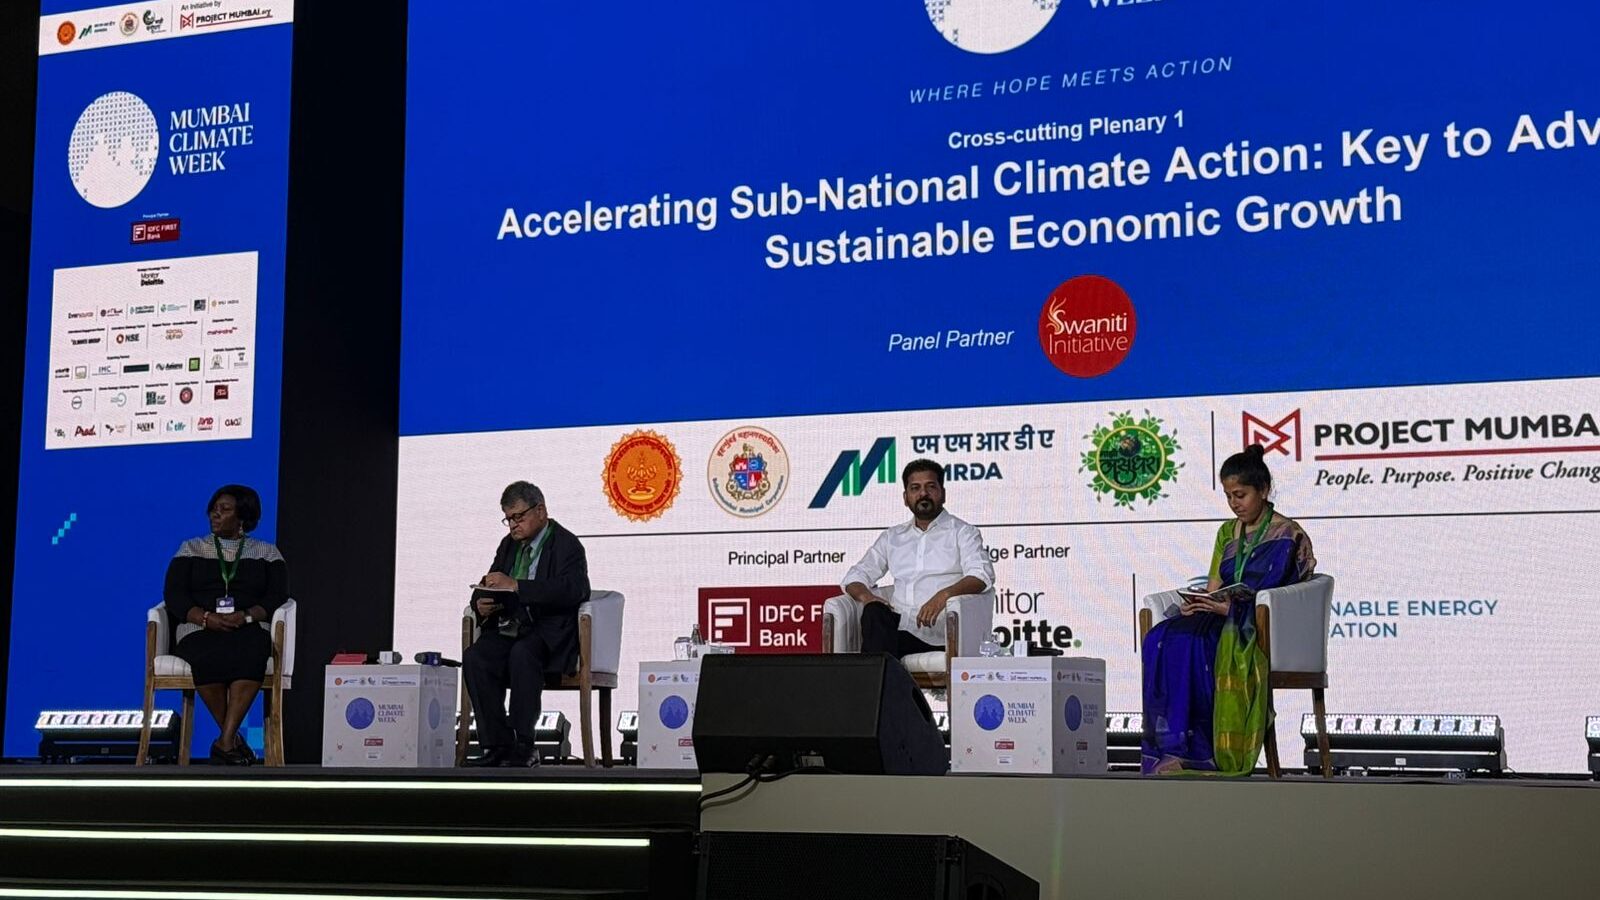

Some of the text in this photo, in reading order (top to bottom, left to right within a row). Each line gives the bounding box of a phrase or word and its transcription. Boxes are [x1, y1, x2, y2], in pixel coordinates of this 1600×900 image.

[196, 13, 228, 24] PROJECT
[910, 56, 1233, 104] WHERE HOPE MEETS ACTION
[170, 102, 250, 131] MUMBAI
[169, 124, 254, 154] CLIMATE
[947, 109, 1185, 150] Cross-cutting Plenary 1
[169, 150, 226, 176] WEEK
[497, 110, 1600, 240] Accelerating Sub-National Climate Action: Key to Adv
[765, 185, 1402, 270] Sustainable Economic Growth
[1053, 310, 1128, 335] Swaniti
[125, 333, 140, 342] NSE
[888, 329, 1014, 352] Panel Partner
[1049, 332, 1129, 355] Initiative
[910, 424, 1056, 454] एम एम आर डी ए
[1314, 413, 1600, 450] PROJECT MUMBA
[943, 461, 1004, 482] RDA
[1315, 460, 1600, 490] People. Purpose. Positive Chang
[728, 549, 846, 569] Principal Partner
[1014, 544, 1071, 559] Partner
[759, 604, 805, 623] IDFC
[1407, 599, 1499, 617] ENERGY
[759, 629, 807, 647] Bank
[1007, 702, 1035, 710] MUMBAI
[1007, 709, 1036, 717] CLIMATE
